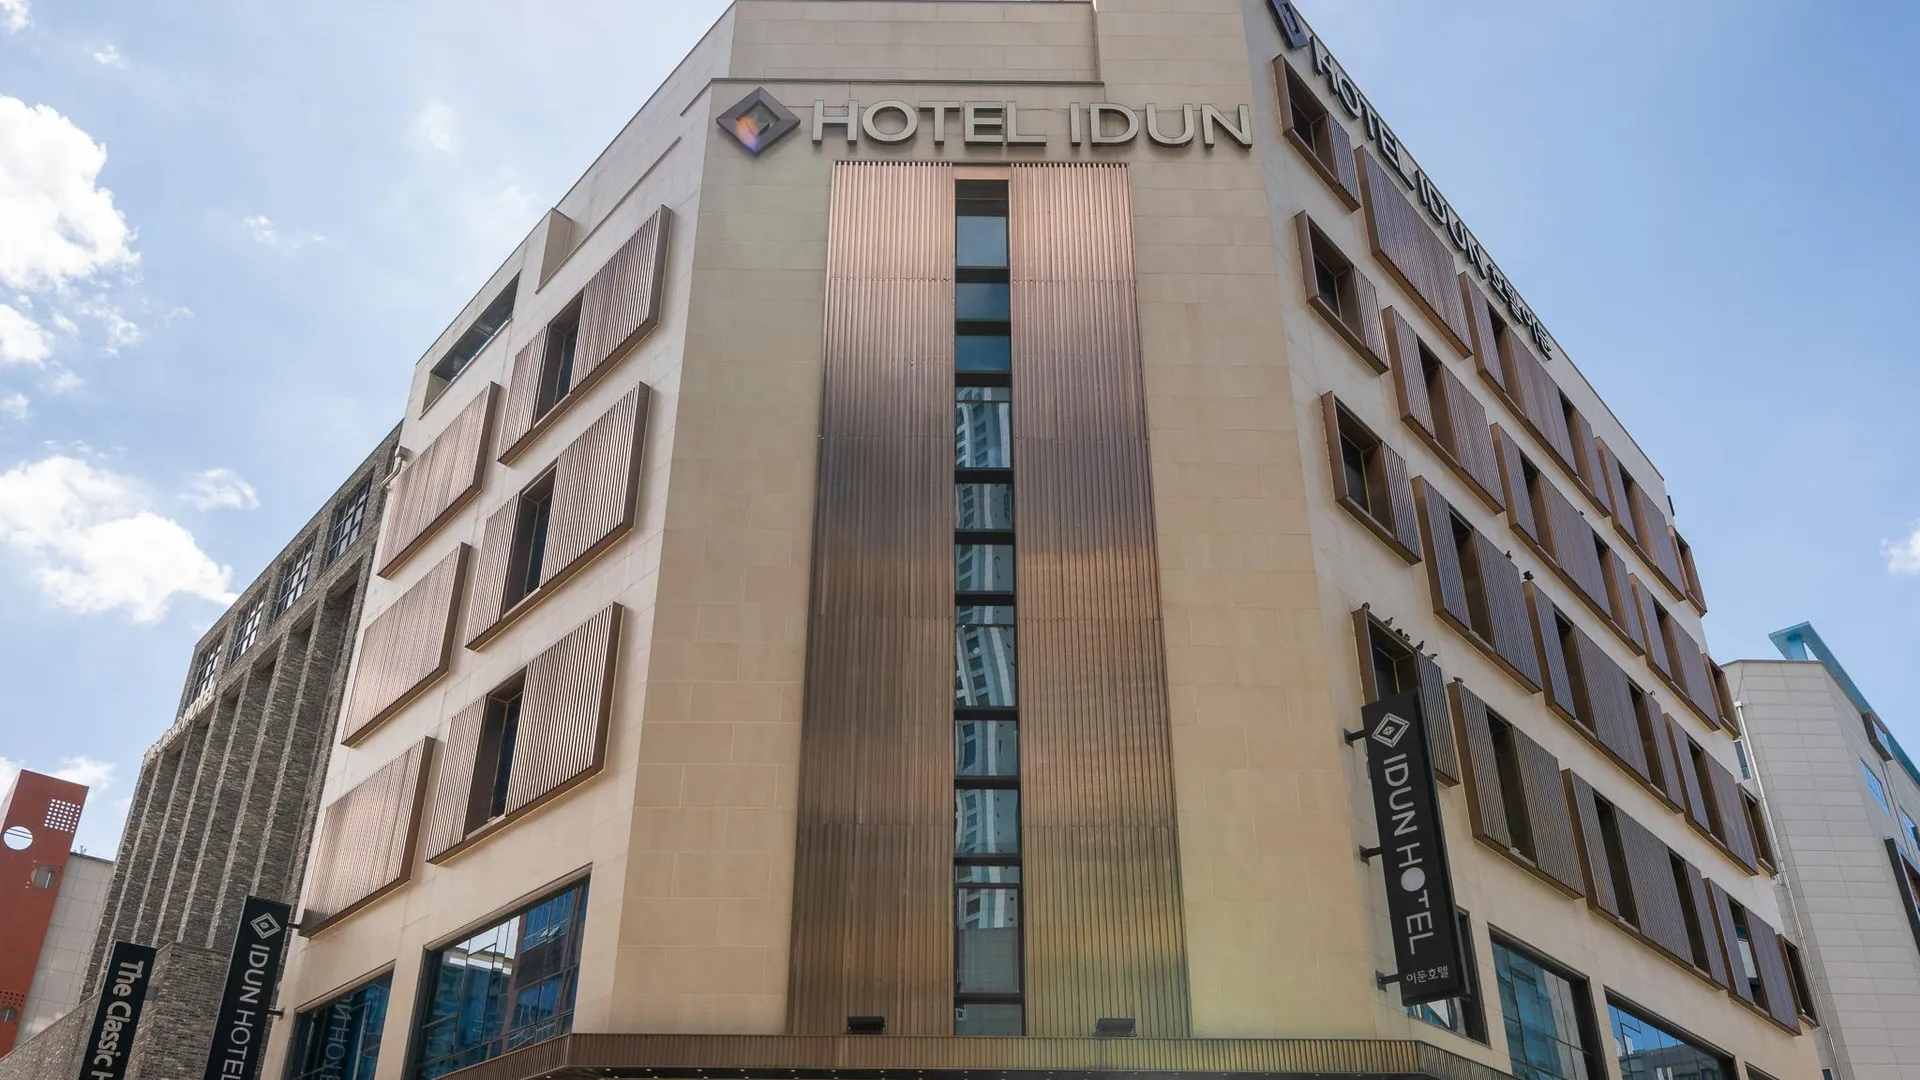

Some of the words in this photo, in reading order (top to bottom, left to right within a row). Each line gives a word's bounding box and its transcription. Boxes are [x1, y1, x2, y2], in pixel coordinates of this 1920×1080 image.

[812, 99, 1047, 147] HOTEL
[1069, 101, 1253, 150] IDUN
[1309, 35, 1416, 191] HOTEL
[1414, 169, 1487, 280] IDUN
[1383, 753, 1418, 837] IDUN
[1396, 842, 1434, 955] HOTEL
[112, 960, 144, 997] The
[239, 943, 270, 1004] IDUN
[1406, 965, 1449, 984] 이둔호텔
[93, 1001, 132, 1067] Classic
